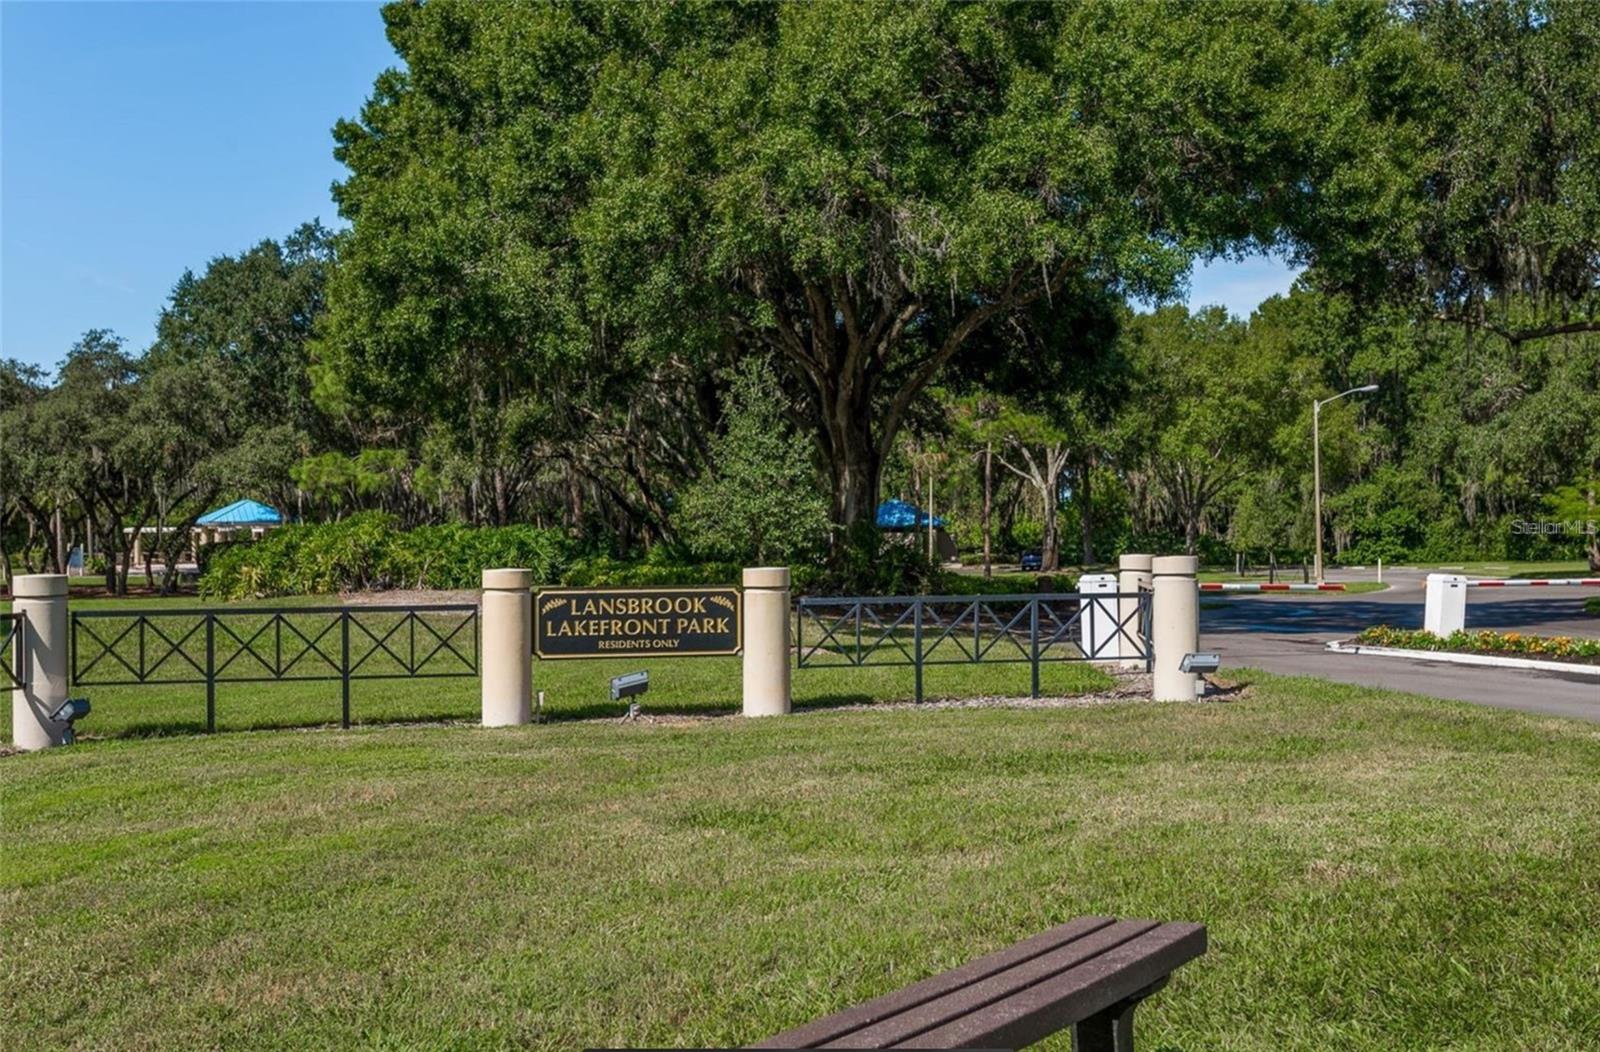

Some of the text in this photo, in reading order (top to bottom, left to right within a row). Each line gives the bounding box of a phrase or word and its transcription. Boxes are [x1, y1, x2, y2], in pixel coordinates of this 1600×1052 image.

[570, 596, 706, 616] LANSBROOK
[546, 616, 730, 637] LAKEFRONT PARK
[598, 638, 680, 649] RESIDENTS ONLY
